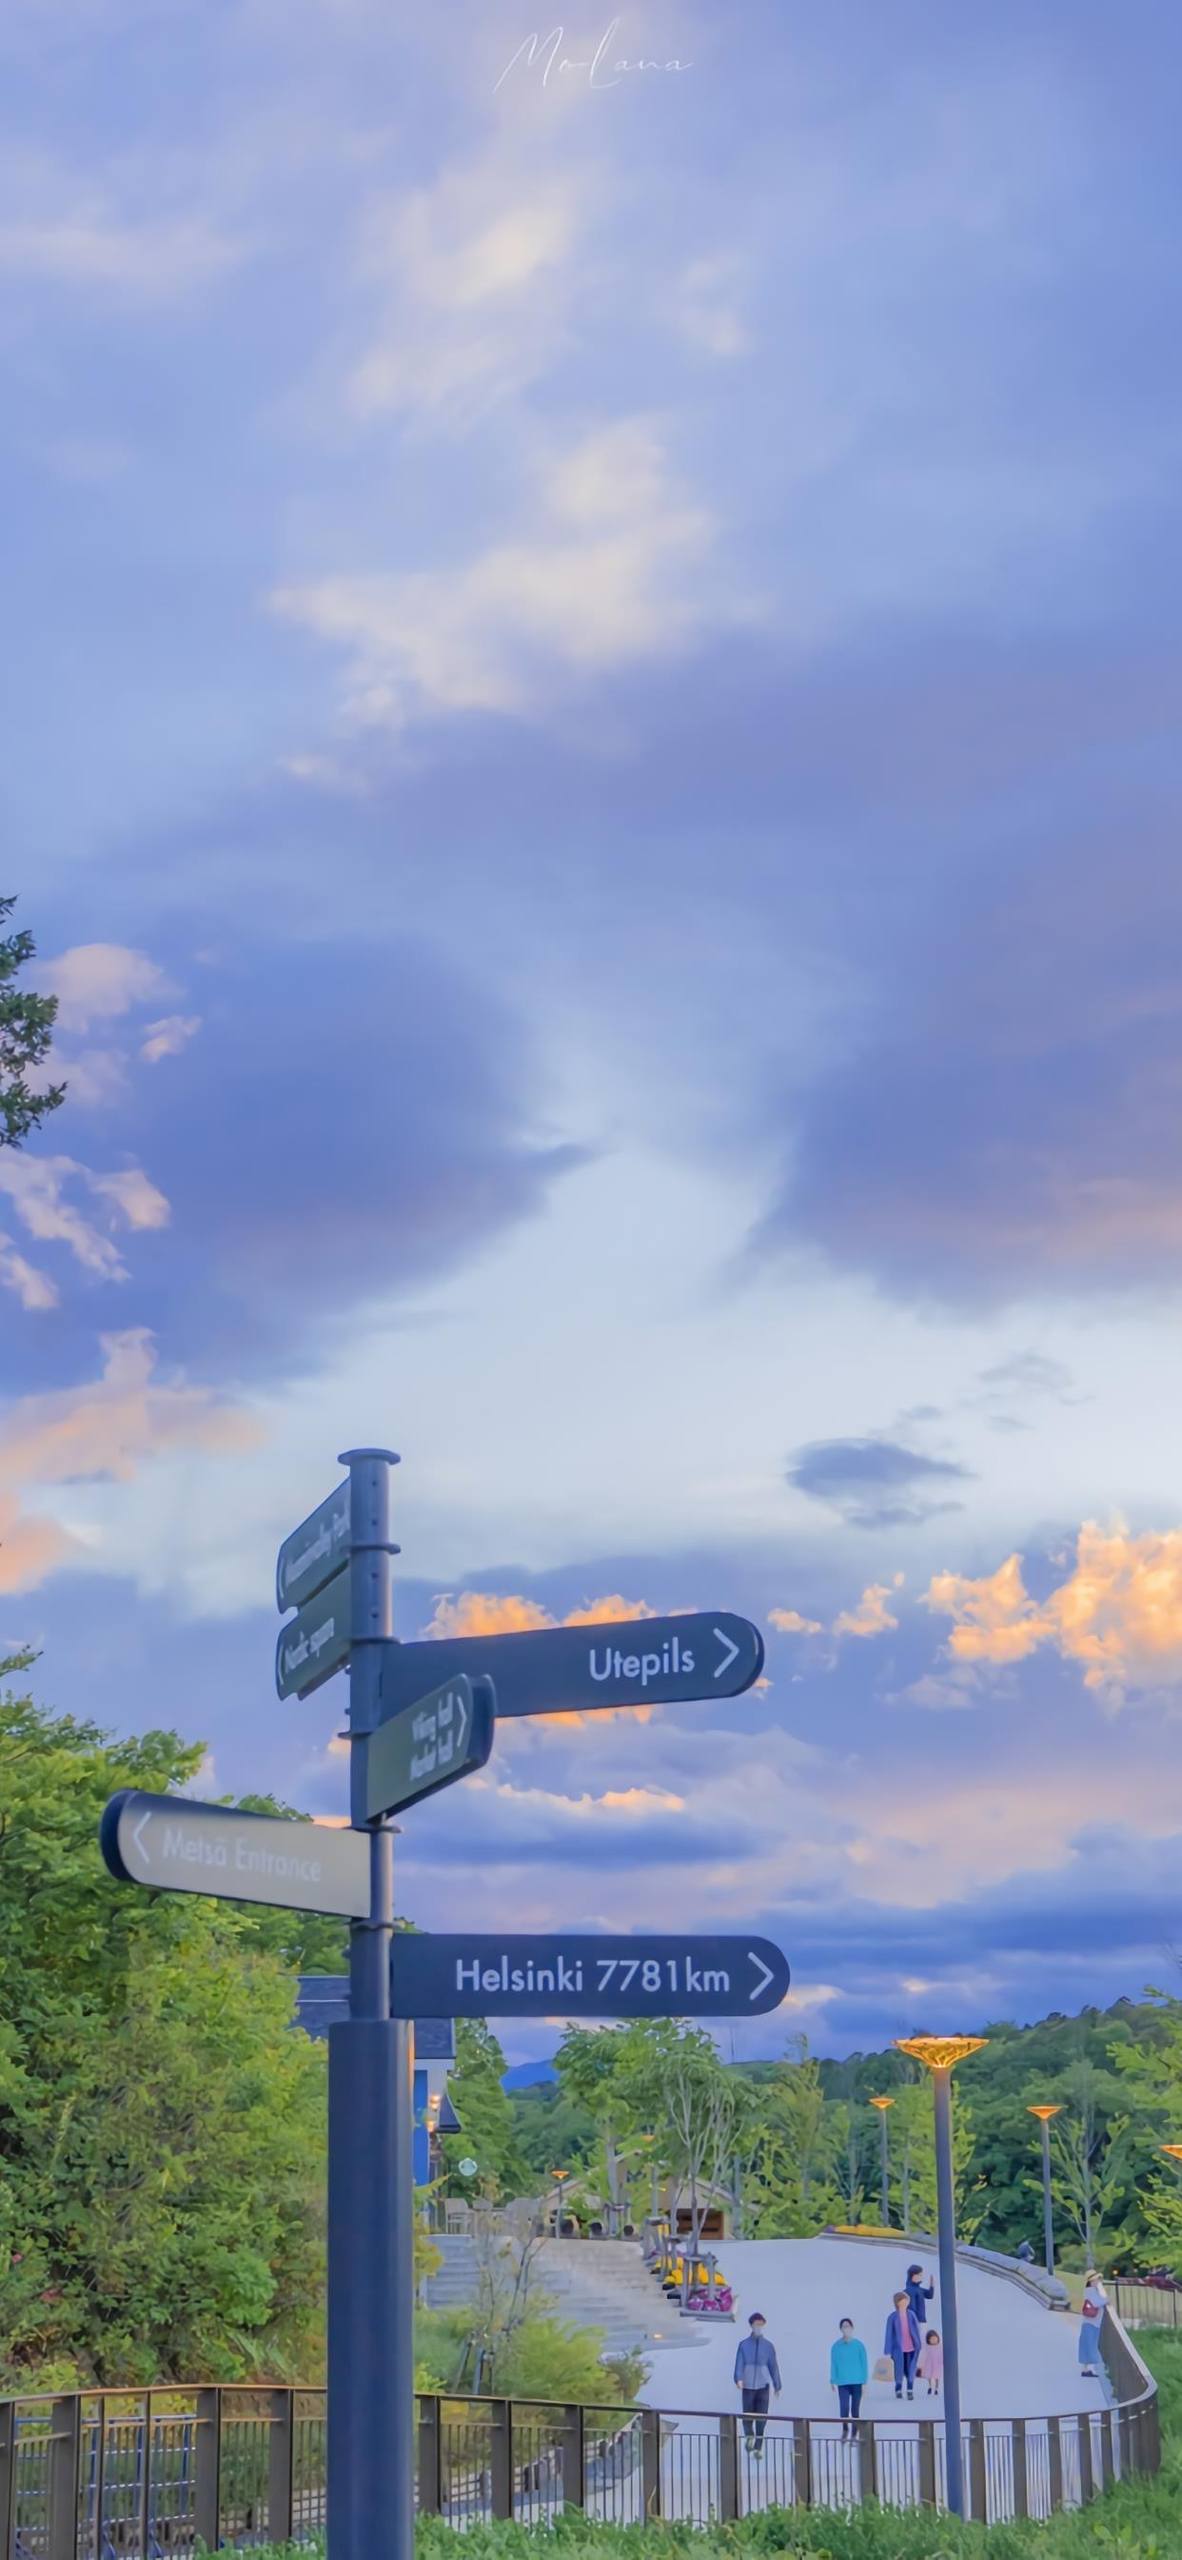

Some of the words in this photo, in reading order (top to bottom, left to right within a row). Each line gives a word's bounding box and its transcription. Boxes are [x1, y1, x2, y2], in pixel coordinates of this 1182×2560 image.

[589, 1636, 695, 1686] Utepils
[234, 1836, 322, 1882] Entrance
[455, 1954, 583, 1992] Helsinki
